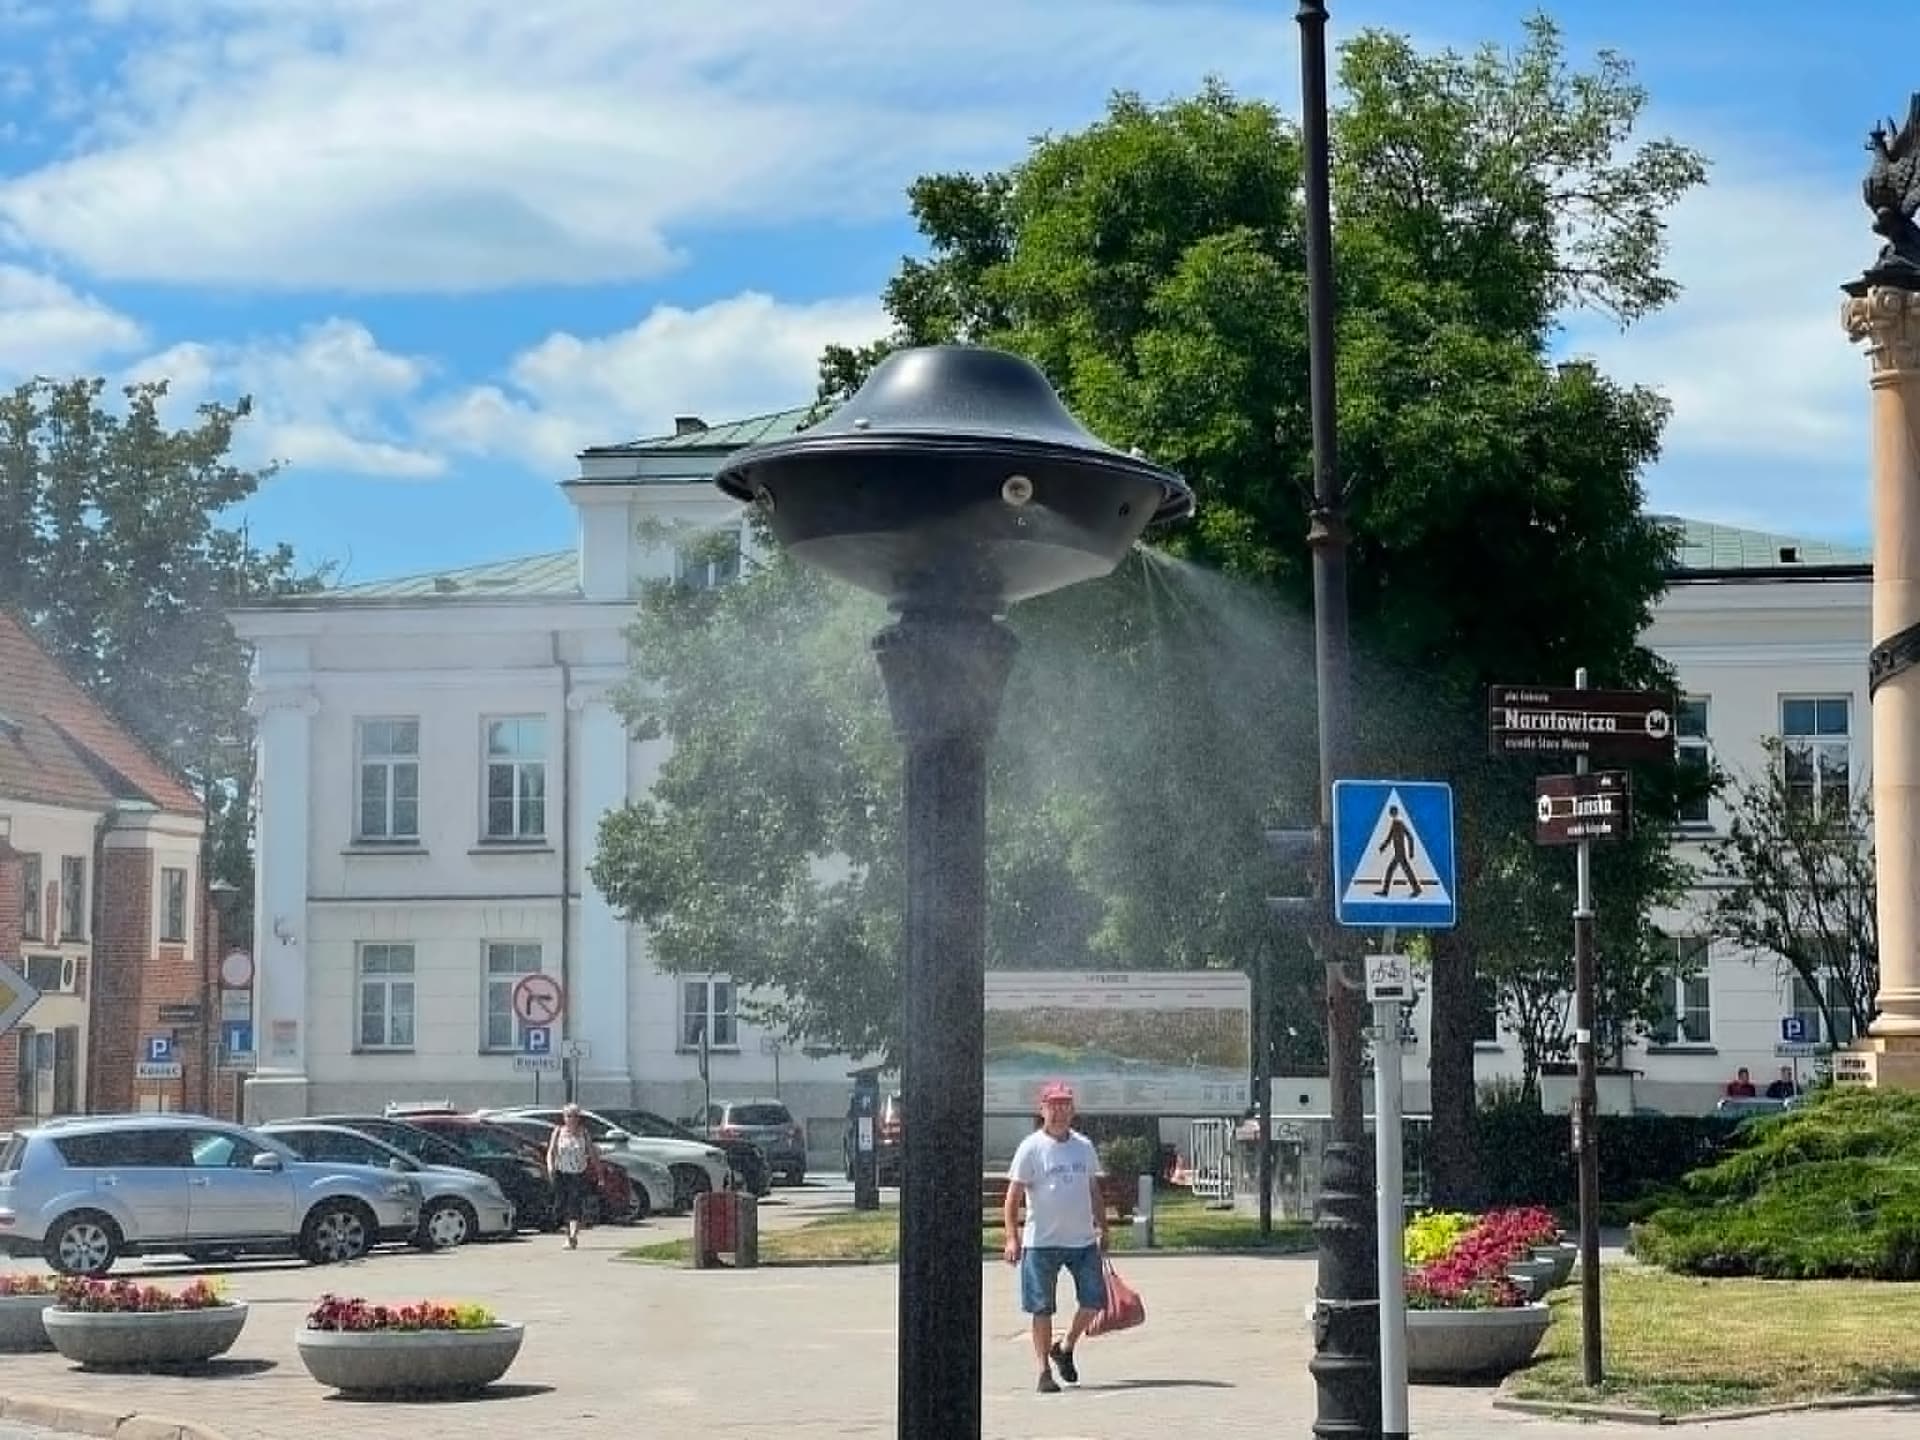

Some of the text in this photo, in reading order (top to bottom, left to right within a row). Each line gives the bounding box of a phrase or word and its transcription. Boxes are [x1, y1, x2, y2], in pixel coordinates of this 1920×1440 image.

[1505, 708, 1616, 732] Narutowicza
[152, 1040, 167, 1058] P
[530, 1030, 544, 1050] P
